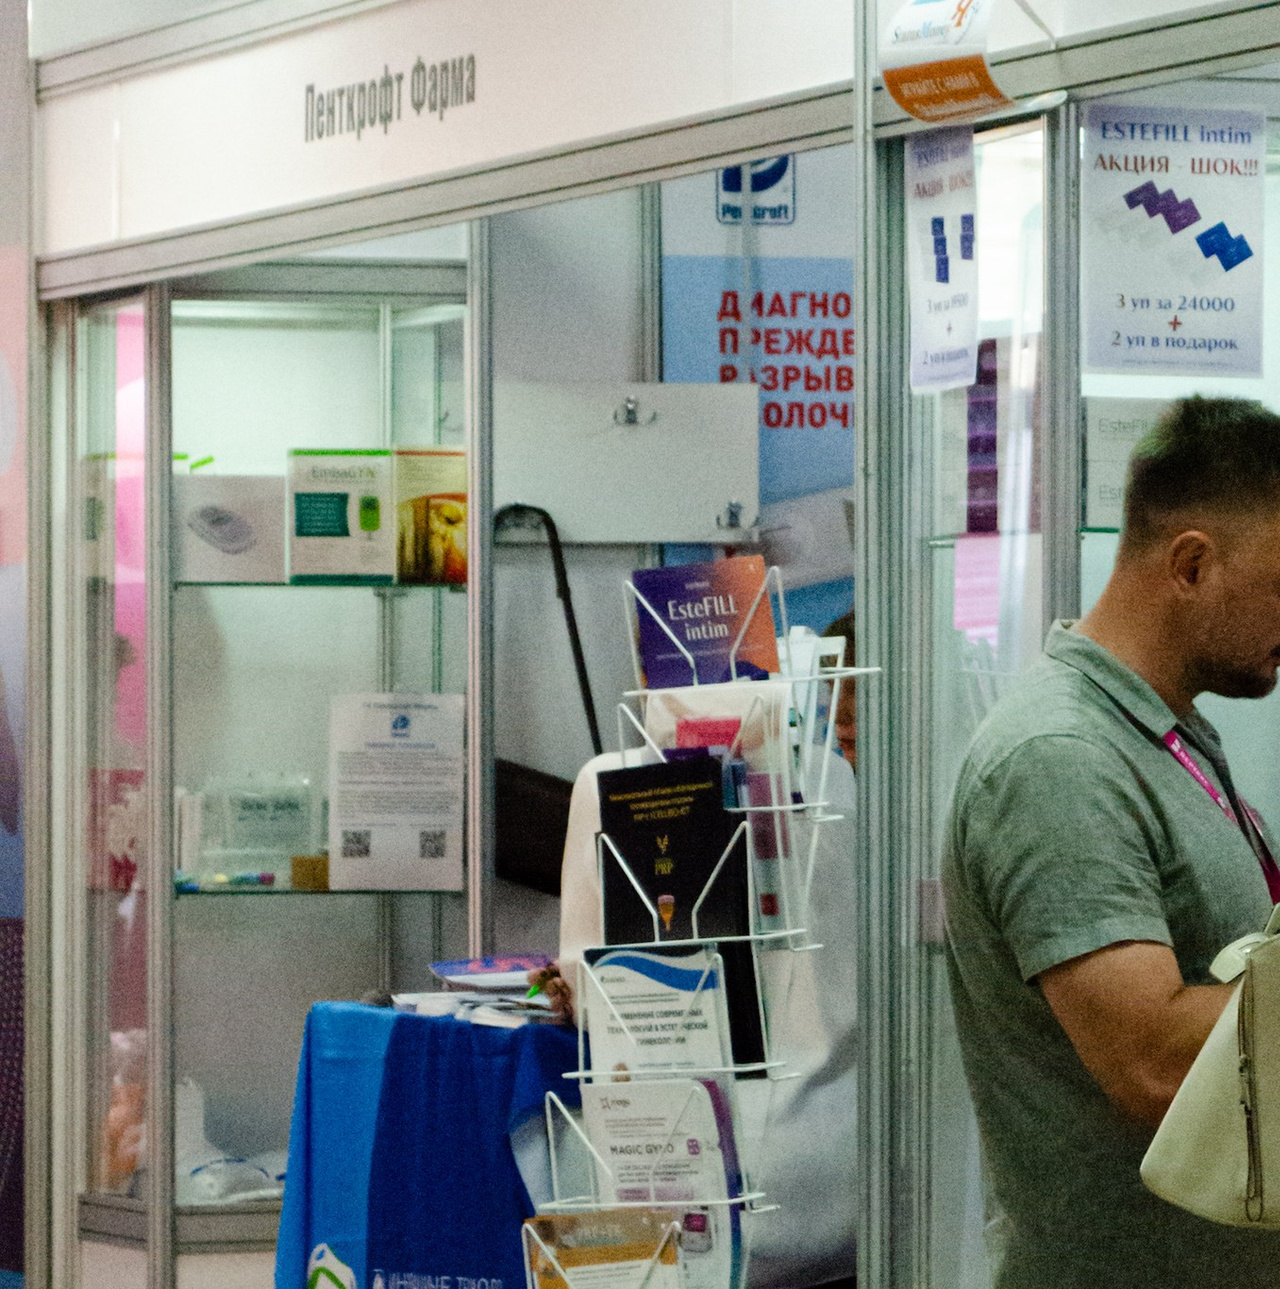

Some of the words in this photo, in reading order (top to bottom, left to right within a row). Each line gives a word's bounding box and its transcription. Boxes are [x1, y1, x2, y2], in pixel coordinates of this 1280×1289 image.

[305, 63, 404, 143] Пенткрофт
[411, 53, 476, 122] Фарма
[1101, 121, 1193, 142] ESTEFILL
[1200, 124, 1252, 144] intim
[1094, 153, 1170, 175] АКЦИЯ
[1190, 157, 1259, 176] ШОК!!!
[1117, 293, 1126, 309] 3
[1131, 297, 1150, 312] уп
[1178, 295, 1235, 312] 24000
[1112, 331, 1121, 347] 2
[1126, 335, 1145, 349] уп
[1165, 338, 1239, 353] подарок
[719, 365, 854, 392] РЗРЫВ
[667, 595, 738, 620] EsteFILL
[685, 619, 730, 641] intim
